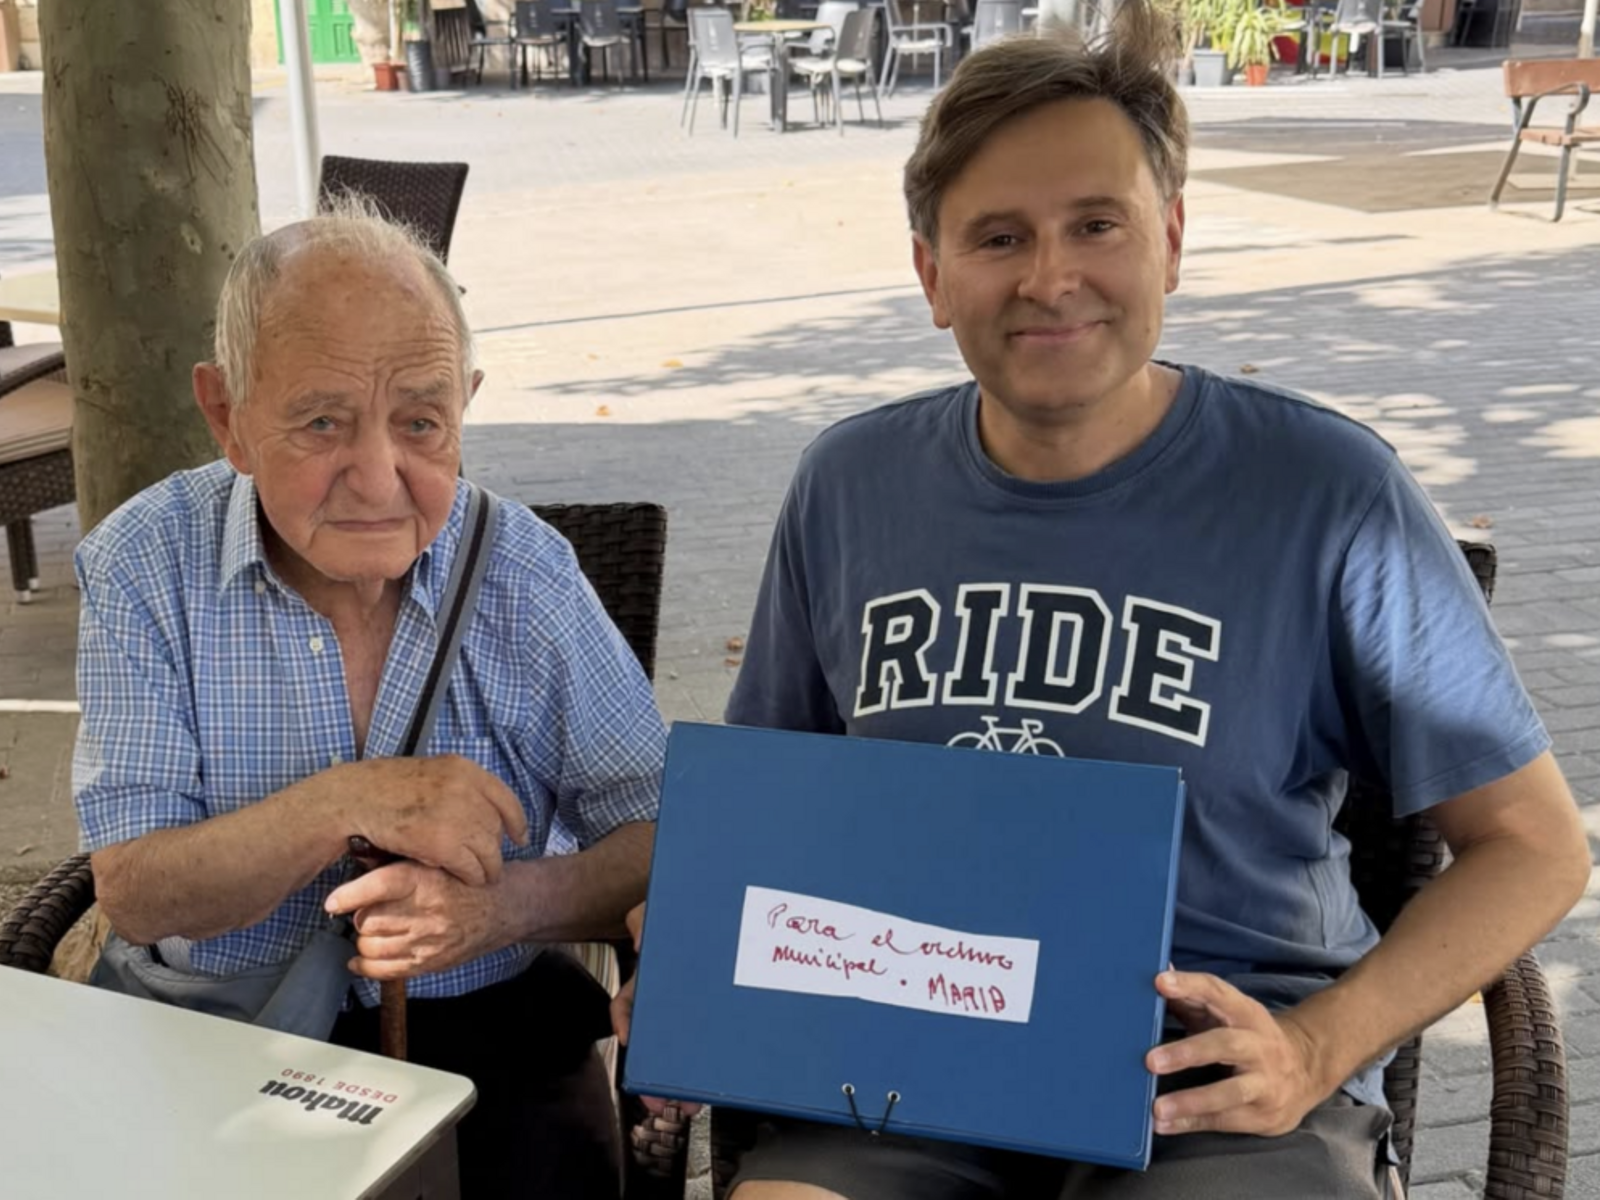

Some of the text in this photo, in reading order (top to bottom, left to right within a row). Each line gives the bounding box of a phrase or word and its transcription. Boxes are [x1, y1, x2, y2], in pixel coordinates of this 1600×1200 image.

[853, 583, 1221, 747] RIDE
[767, 902, 856, 941] Para
[871, 928, 903, 954] el
[280, 1067, 398, 1104] DESDE 1890
